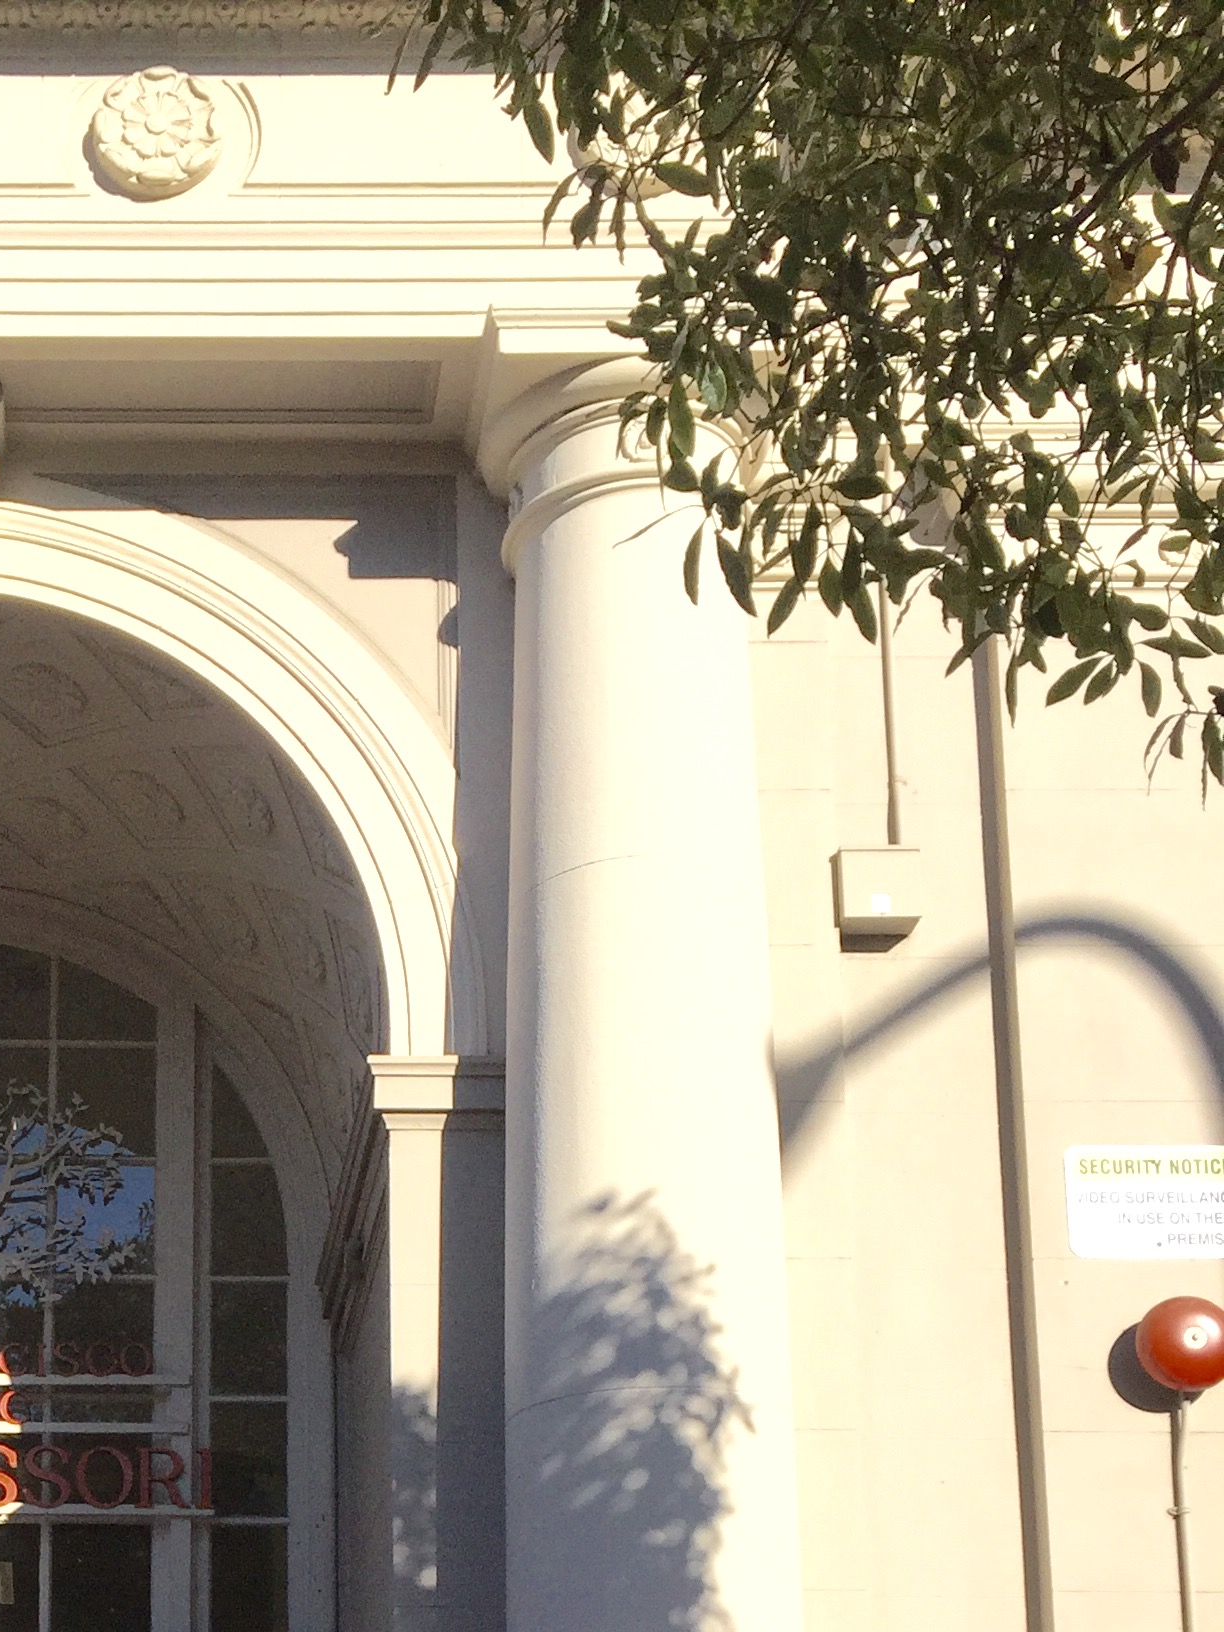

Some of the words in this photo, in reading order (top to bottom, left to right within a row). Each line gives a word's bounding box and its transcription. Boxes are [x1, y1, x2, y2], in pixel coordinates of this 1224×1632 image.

[1079, 1158, 1162, 1175] SECURITY
[1169, 1158, 1224, 1175] NOTIC
[1077, 1191, 1120, 1204] VIDEO
[1118, 1212, 1131, 1224] IN
[1136, 1212, 1165, 1225] USE
[1169, 1212, 1190, 1225] ON
[1196, 1212, 1224, 1225] THE
